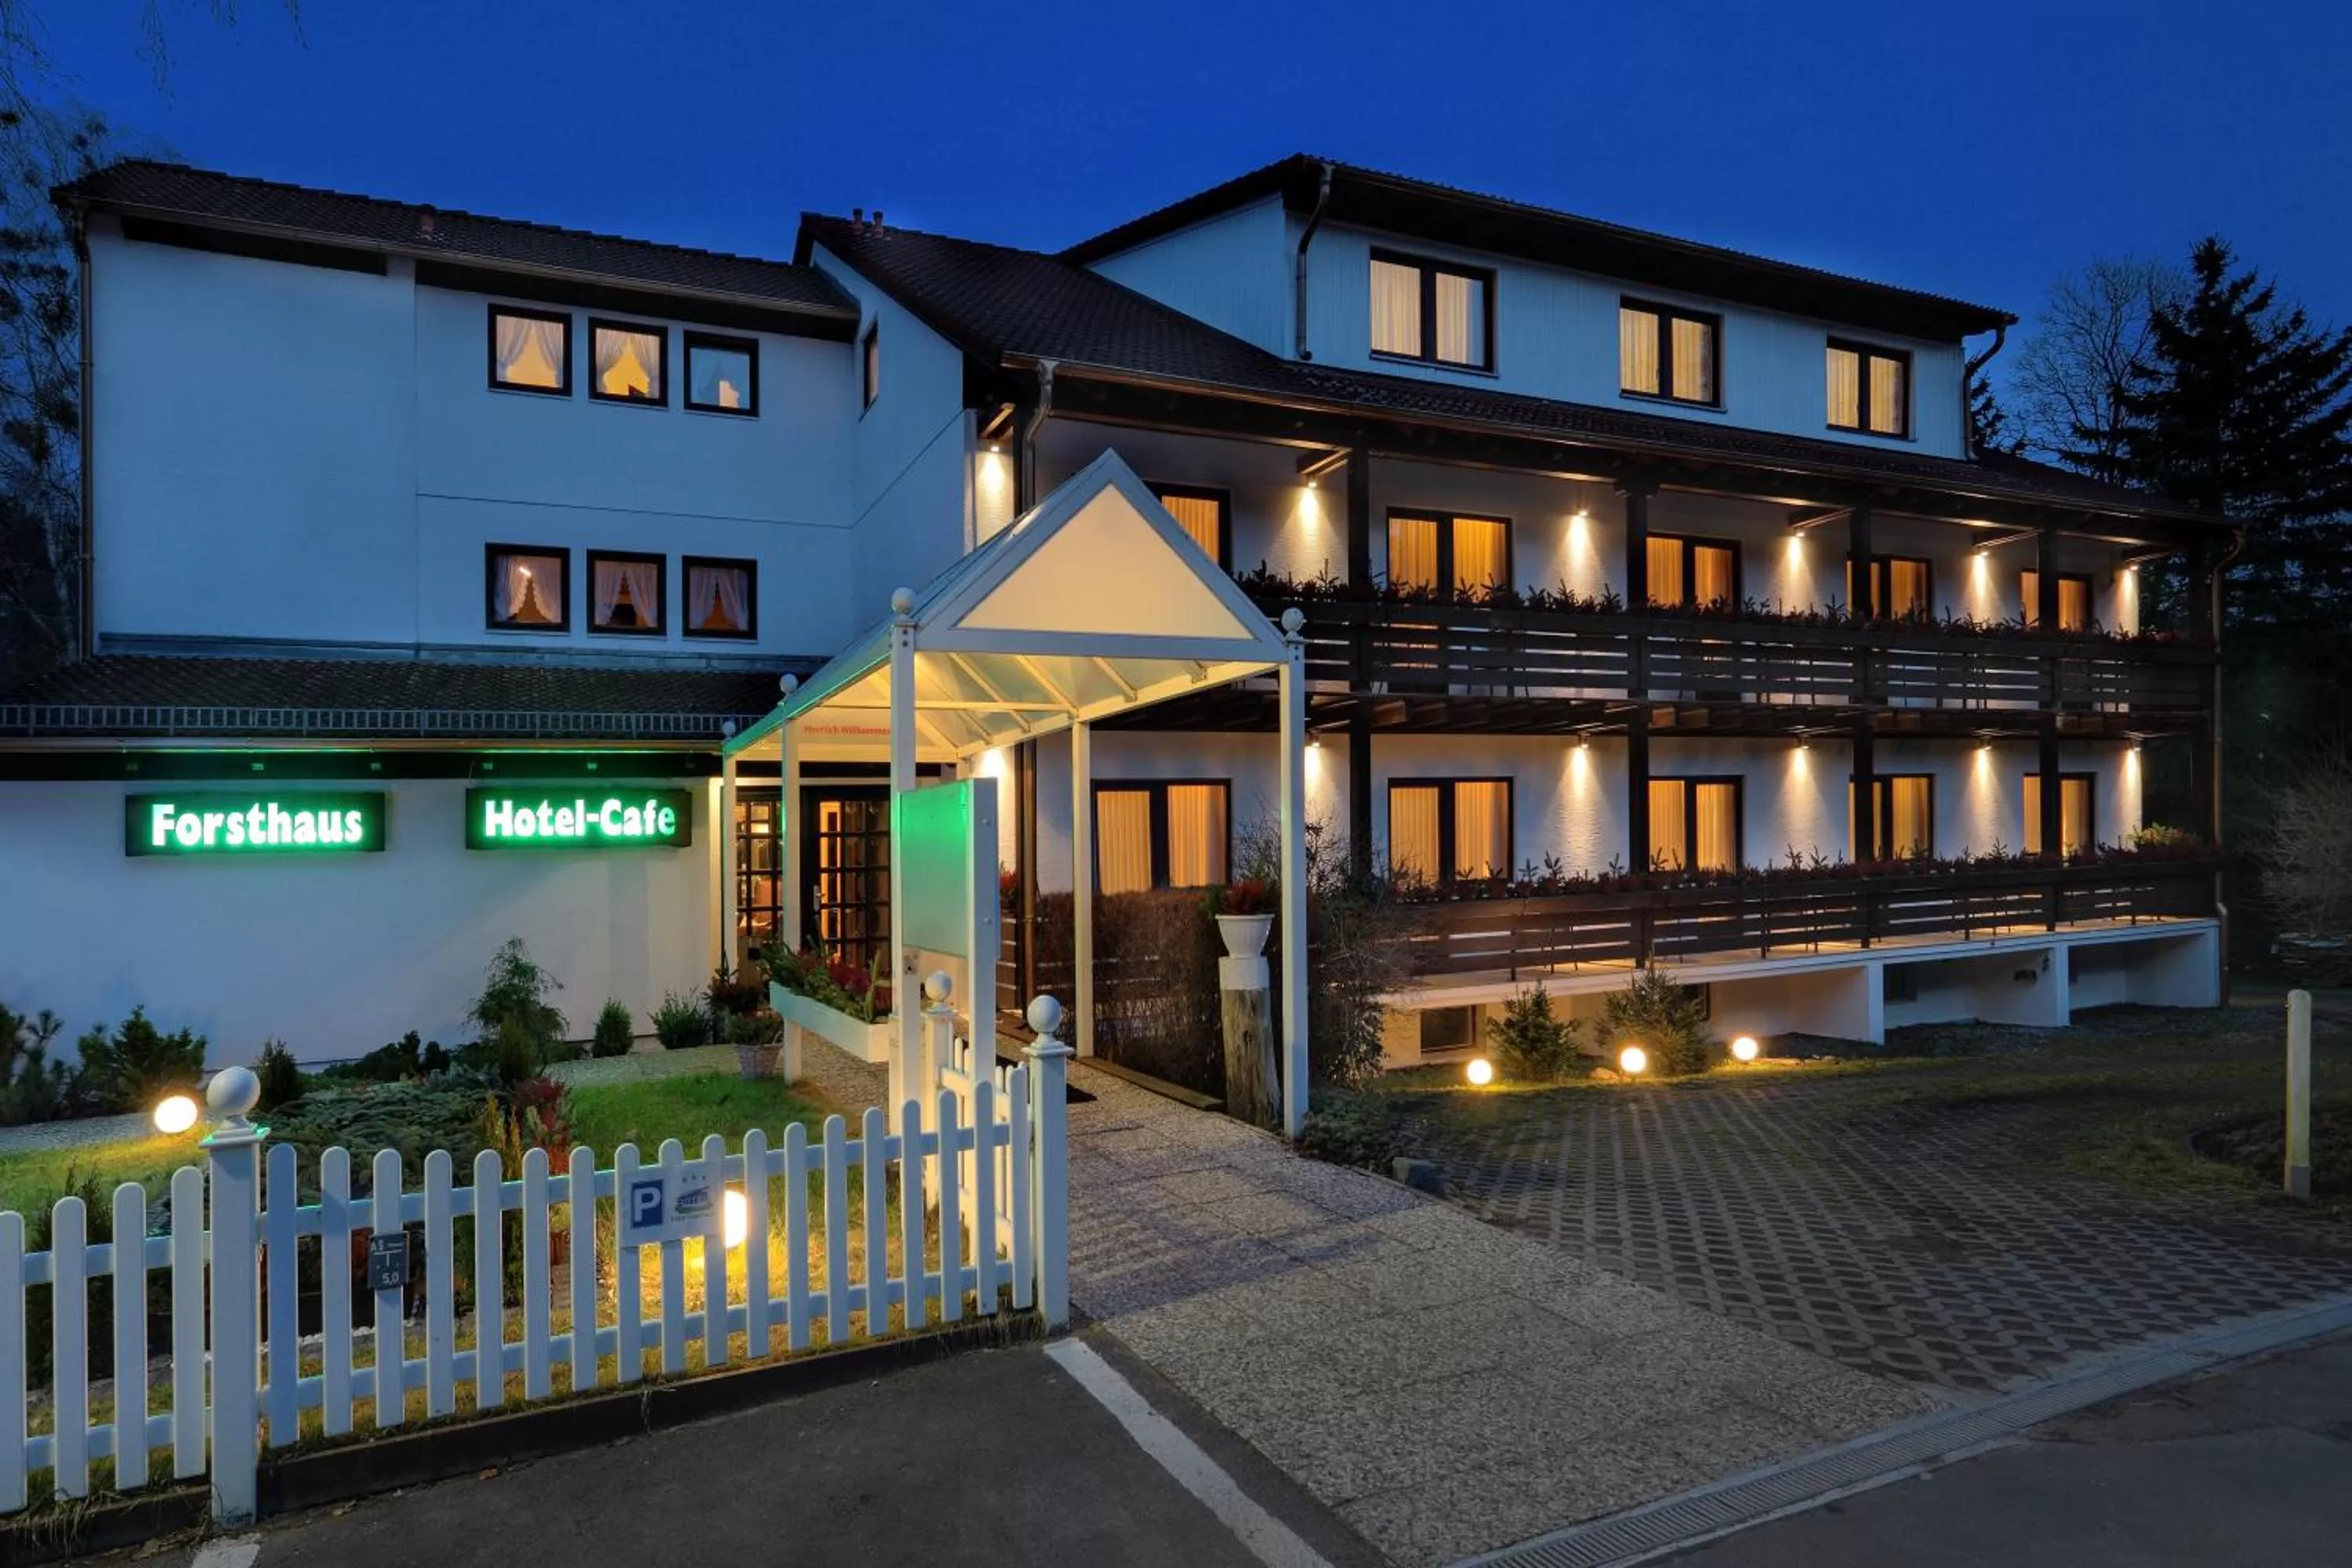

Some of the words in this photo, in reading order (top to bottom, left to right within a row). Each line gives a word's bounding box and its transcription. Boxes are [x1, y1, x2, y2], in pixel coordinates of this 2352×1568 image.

[151, 802, 363, 847] Forsthaus
[485, 797, 676, 837] Hotel-Cafe
[633, 1187, 662, 1222] P
